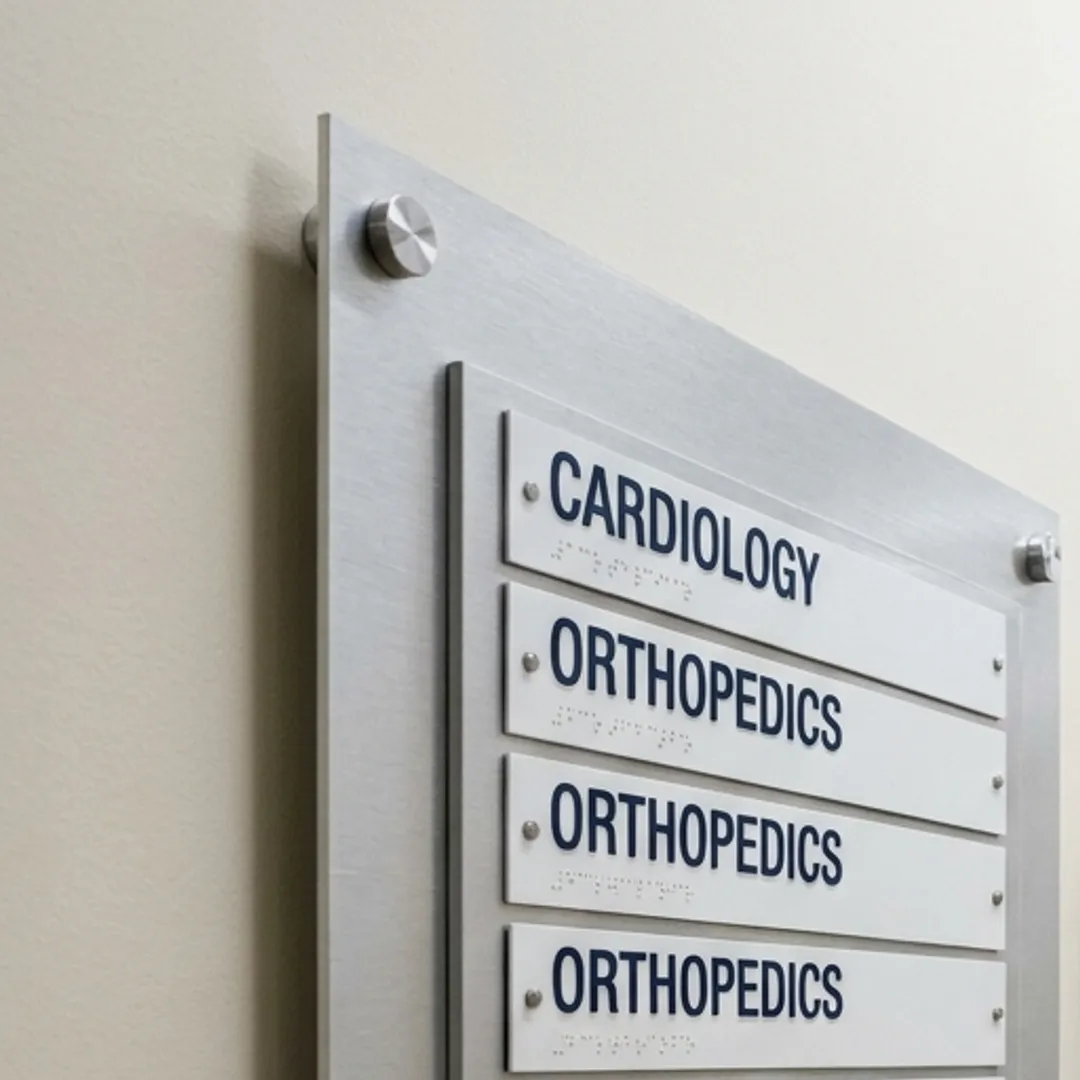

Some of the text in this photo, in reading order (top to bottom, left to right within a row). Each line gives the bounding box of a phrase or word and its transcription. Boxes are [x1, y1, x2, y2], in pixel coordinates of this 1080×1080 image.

[550, 451, 821, 606] CARDIOLOGY
[550, 617, 843, 752] ORTHOPEDICS
[550, 782, 843, 887] ORTHOPEDICS
[552, 946, 843, 1020] ORTHOPEDICS
